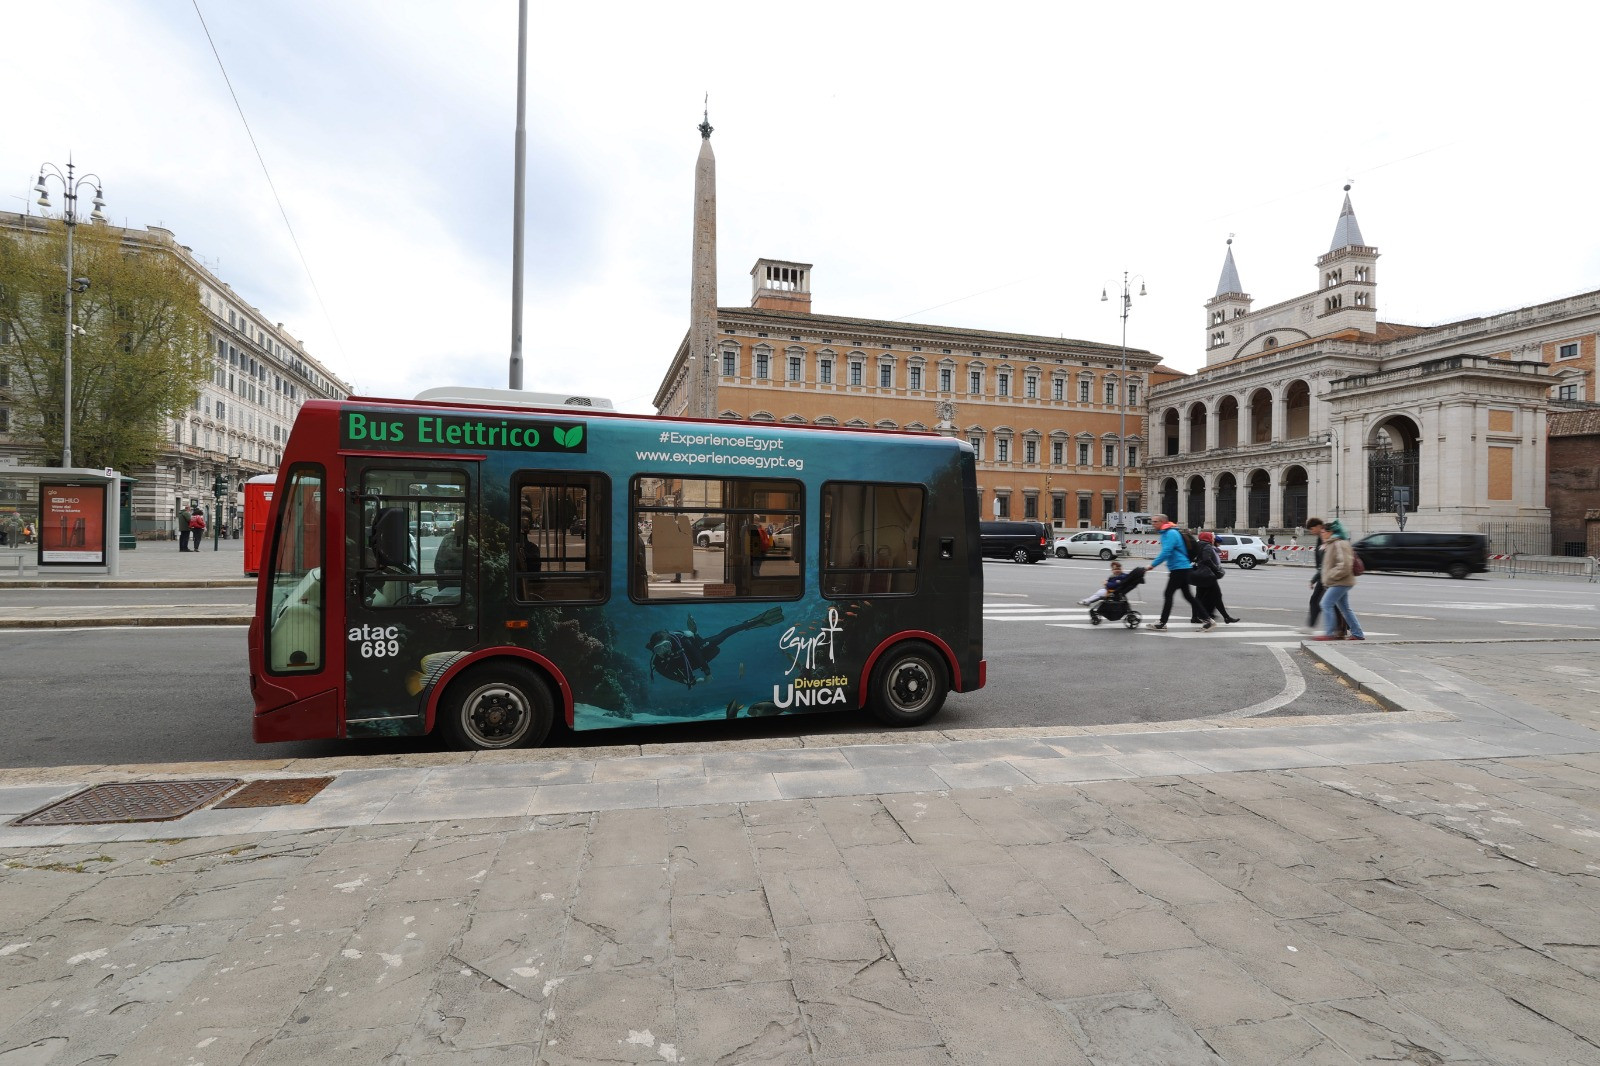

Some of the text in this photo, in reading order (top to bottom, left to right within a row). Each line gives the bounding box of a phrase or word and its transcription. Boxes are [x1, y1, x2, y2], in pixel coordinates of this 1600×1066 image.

[349, 413, 540, 447] Bus Elettrico
[659, 432, 784, 451] #ExperienceEgypt
[636, 451, 804, 470] www.experienceegypt.eg
[348, 624, 398, 641] atac
[361, 640, 399, 658] 689
[794, 675, 848, 688] Diversità
[774, 684, 847, 708] UNICA
